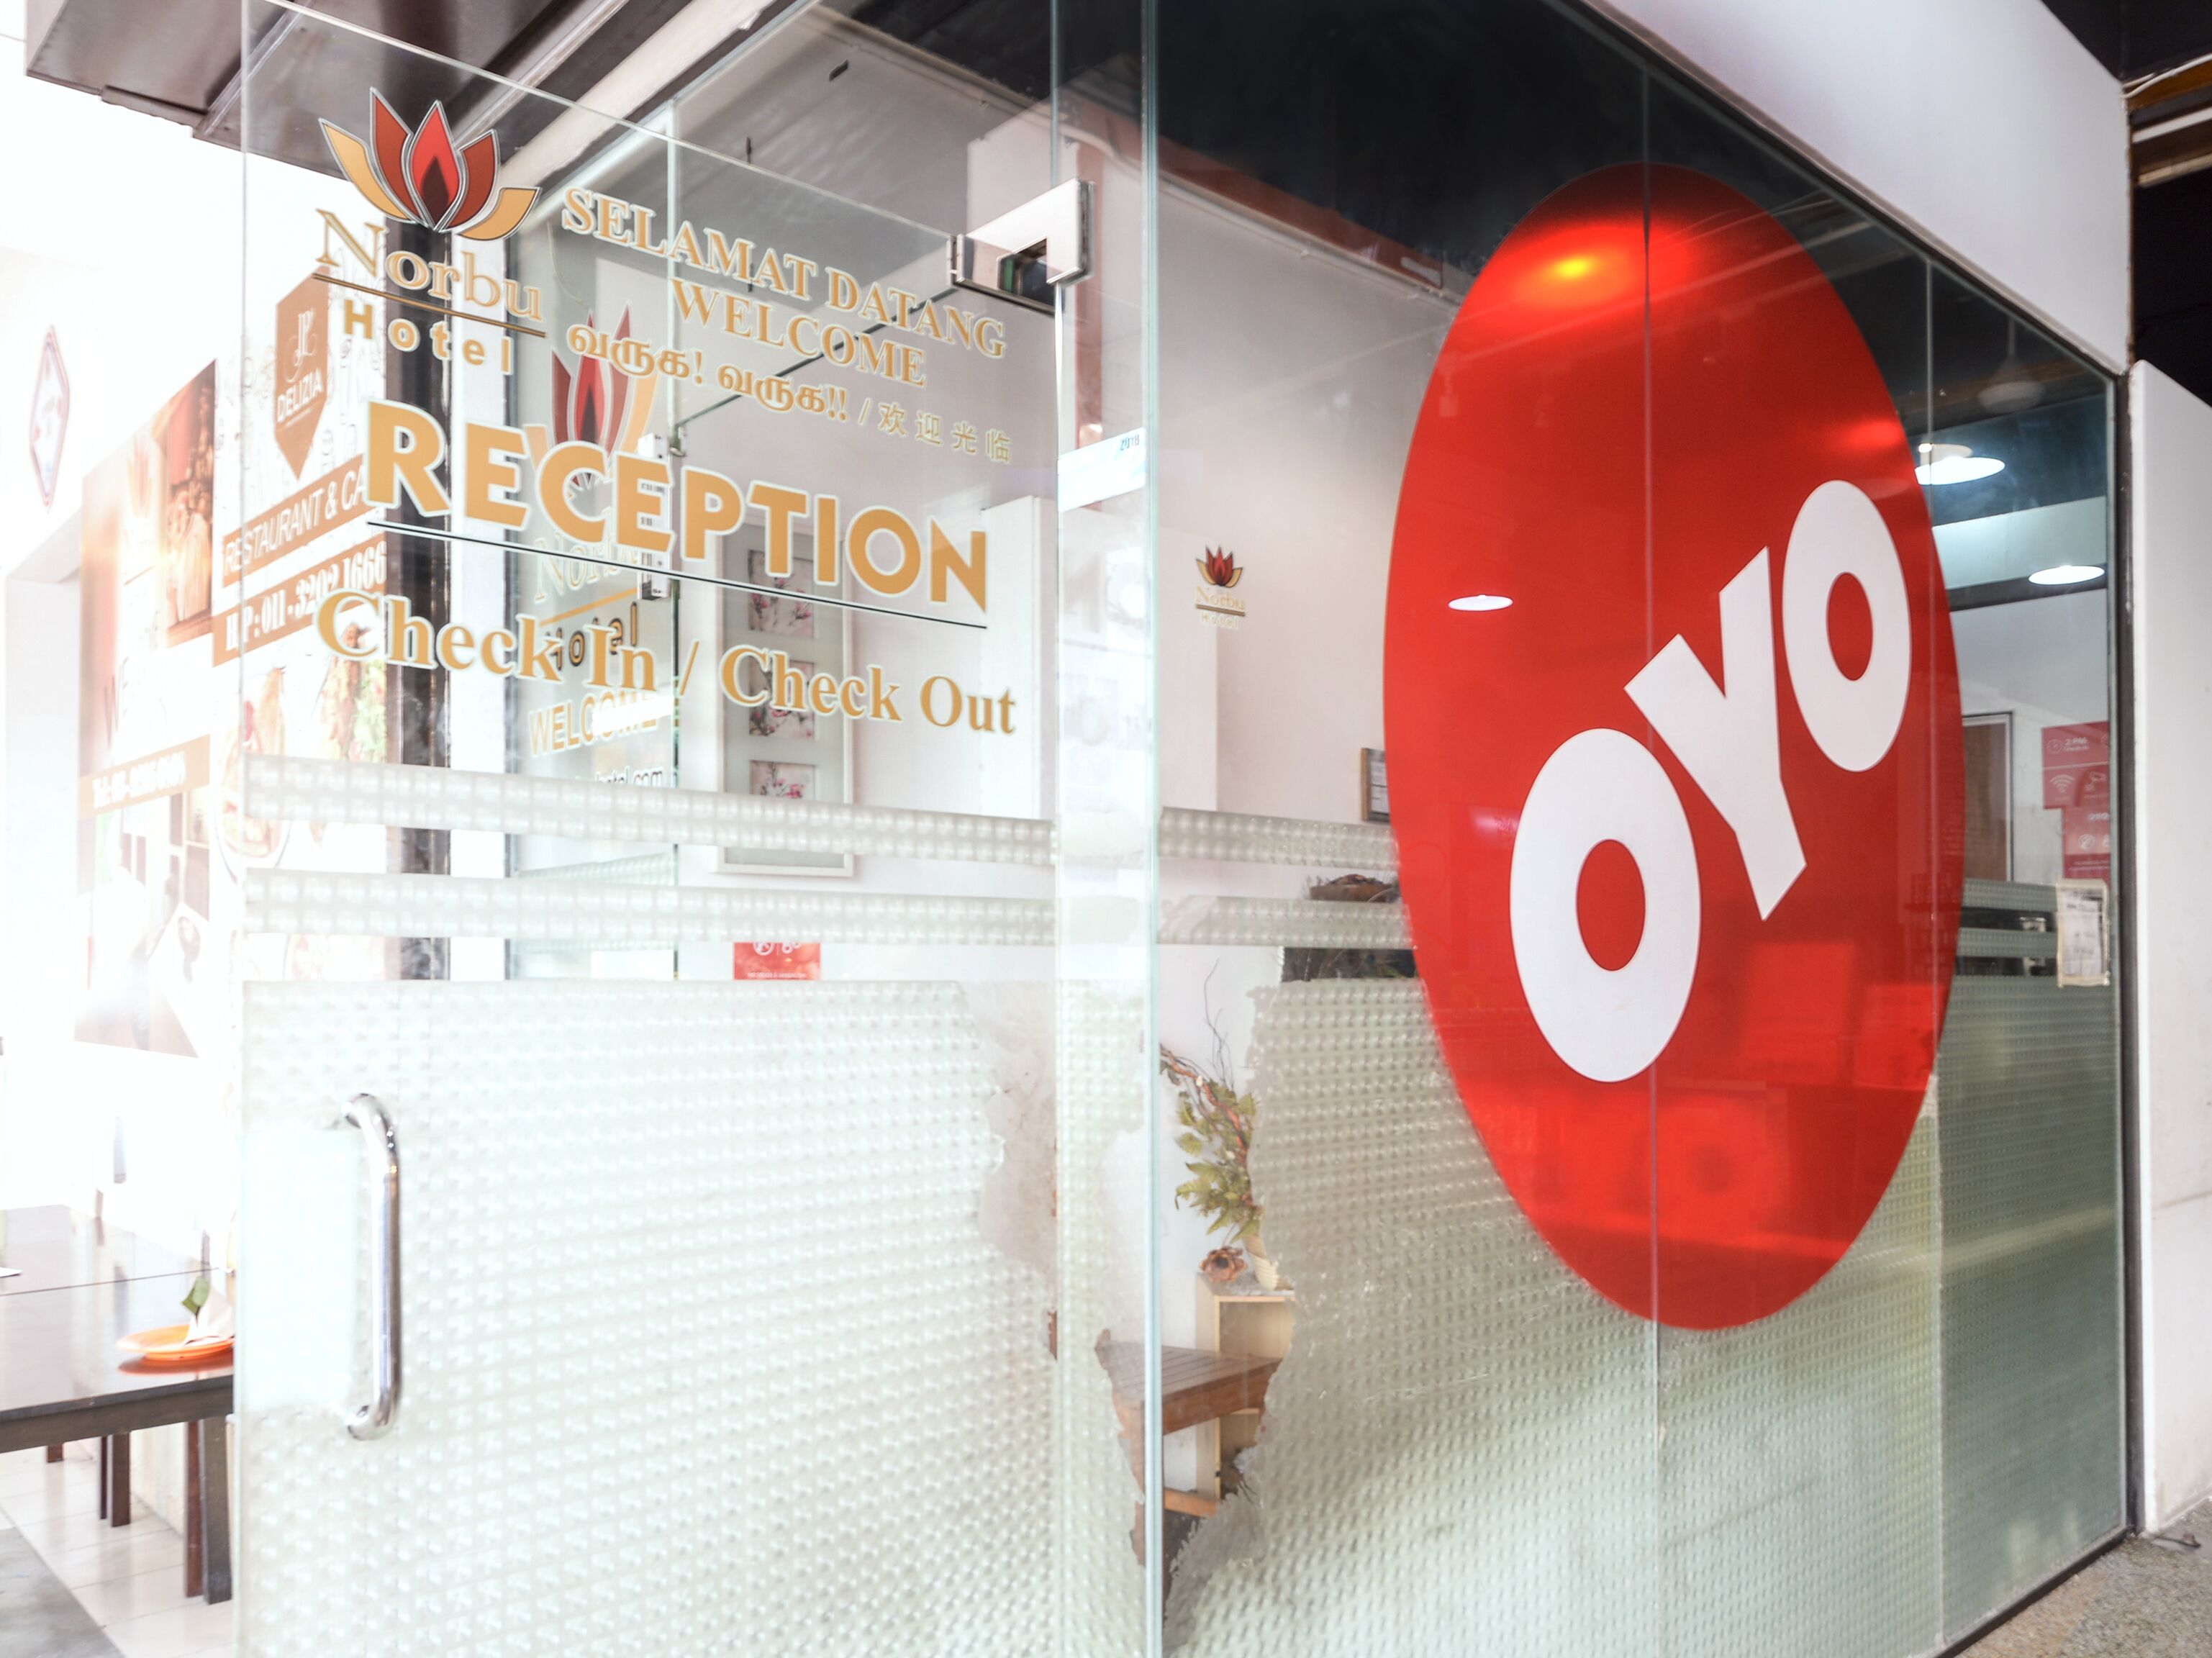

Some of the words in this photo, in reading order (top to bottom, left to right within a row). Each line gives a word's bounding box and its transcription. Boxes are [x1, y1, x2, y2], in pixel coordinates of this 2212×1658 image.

[315, 208, 542, 322] Norbu
[562, 186, 816, 300] SELAMAT
[826, 267, 1005, 358] DATANG
[343, 297, 512, 375] Hotel
[567, 324, 704, 385] வருக!
[717, 363, 849, 422] வருக!!
[671, 277, 926, 388] WELCOME
[277, 368, 323, 423] DELIZIA
[877, 402, 1012, 464] 欢迎光临
[223, 484, 324, 574] RESTAURANT
[366, 399, 988, 615] RECEPTION
[315, 589, 564, 682] Check
[584, 625, 656, 691] In
[720, 645, 903, 722] Check
[920, 674, 1017, 734] Out
[545, 600, 638, 671] oel
[529, 688, 658, 757] WELC
[1510, 479, 1912, 1083] OYO
